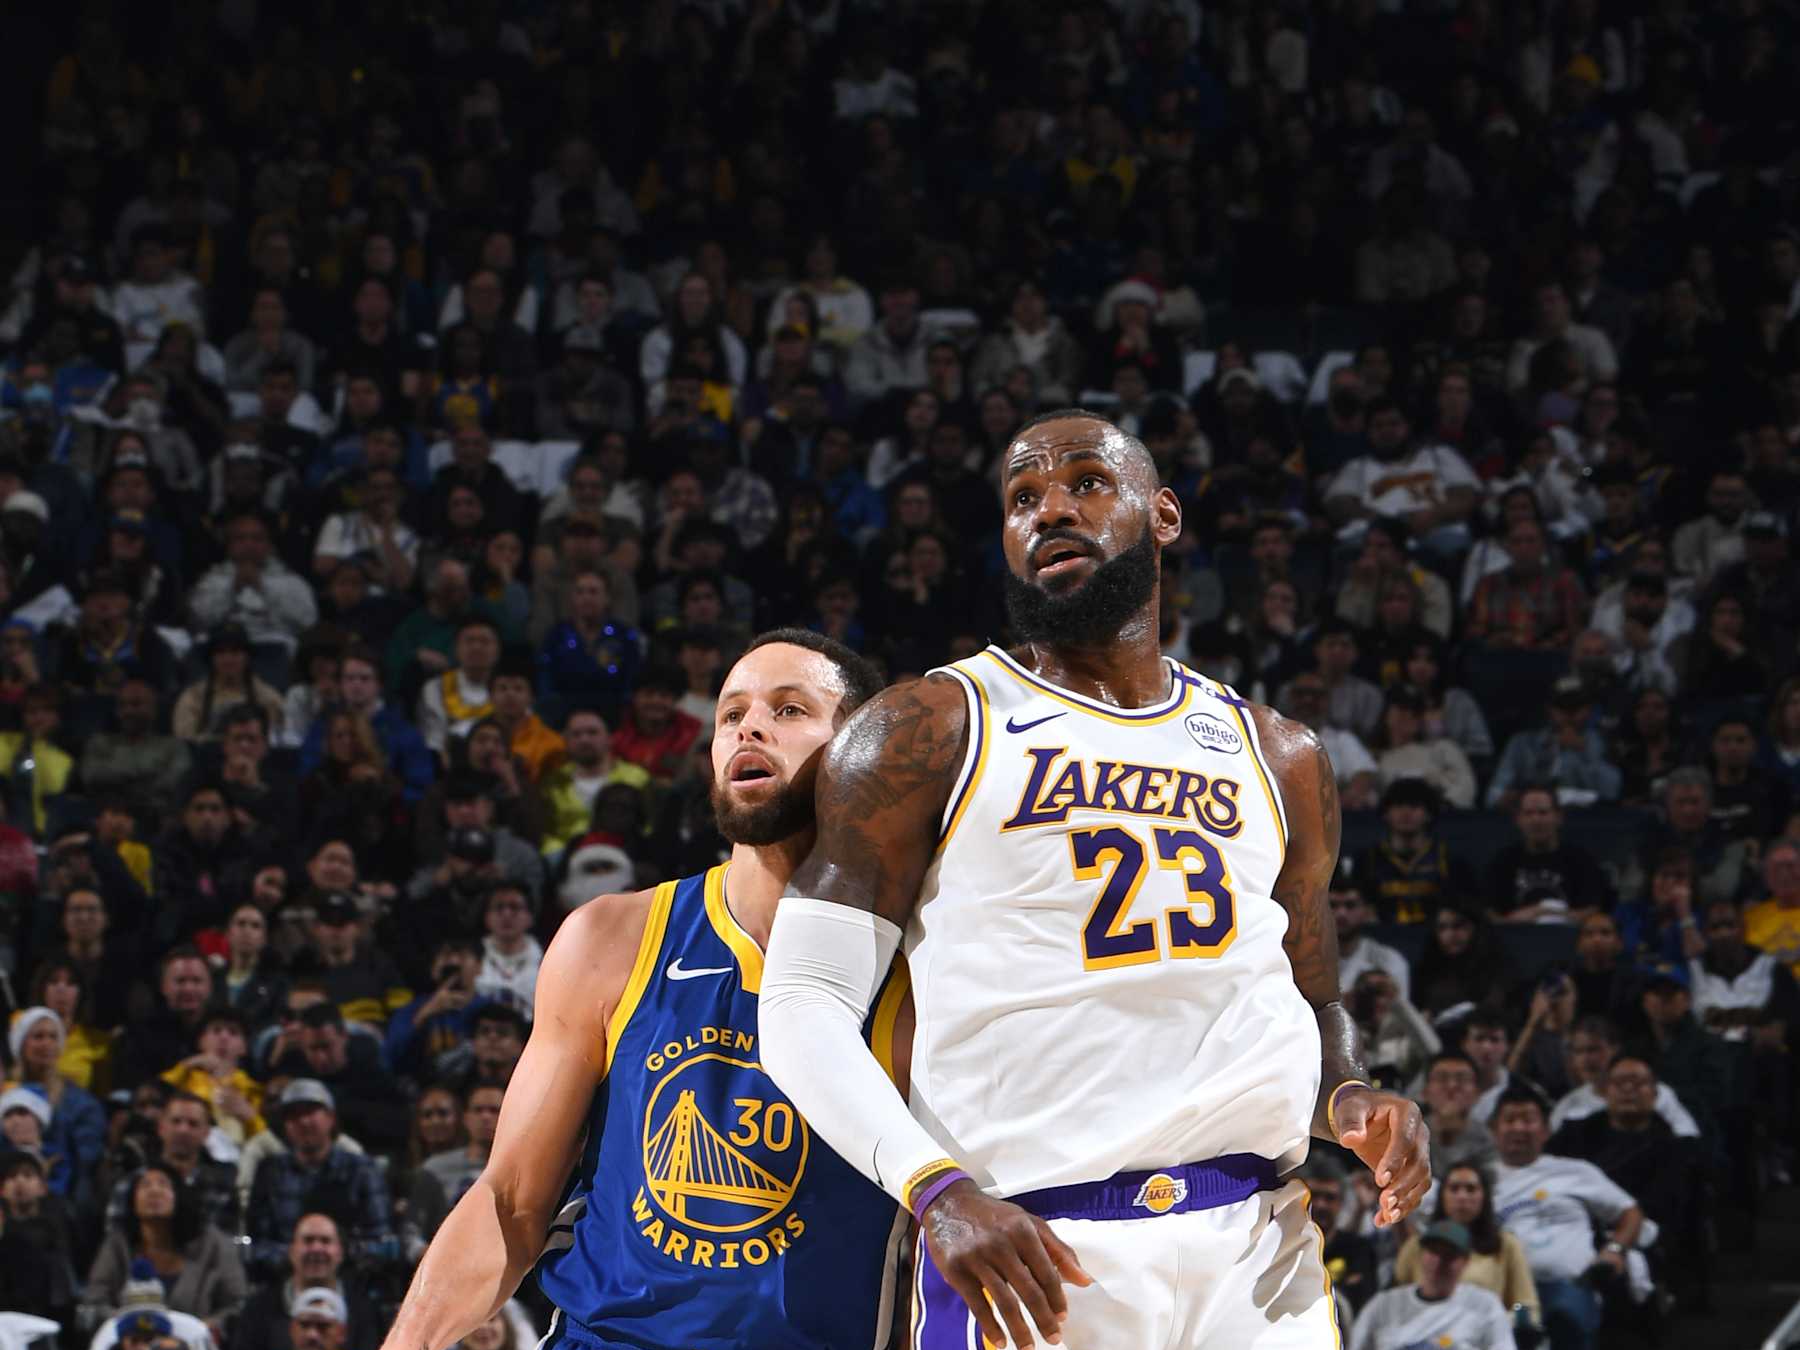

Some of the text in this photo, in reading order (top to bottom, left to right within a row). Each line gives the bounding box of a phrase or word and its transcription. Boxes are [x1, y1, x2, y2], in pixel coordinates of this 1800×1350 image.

[1189, 720, 1239, 744] bibigo
[1001, 746, 1245, 840] LAKERS
[1067, 825, 1238, 971] 23
[646, 1026, 755, 1072] GOLDEN
[728, 1098, 795, 1152] 30
[630, 1186, 806, 1269] WARRIORS
